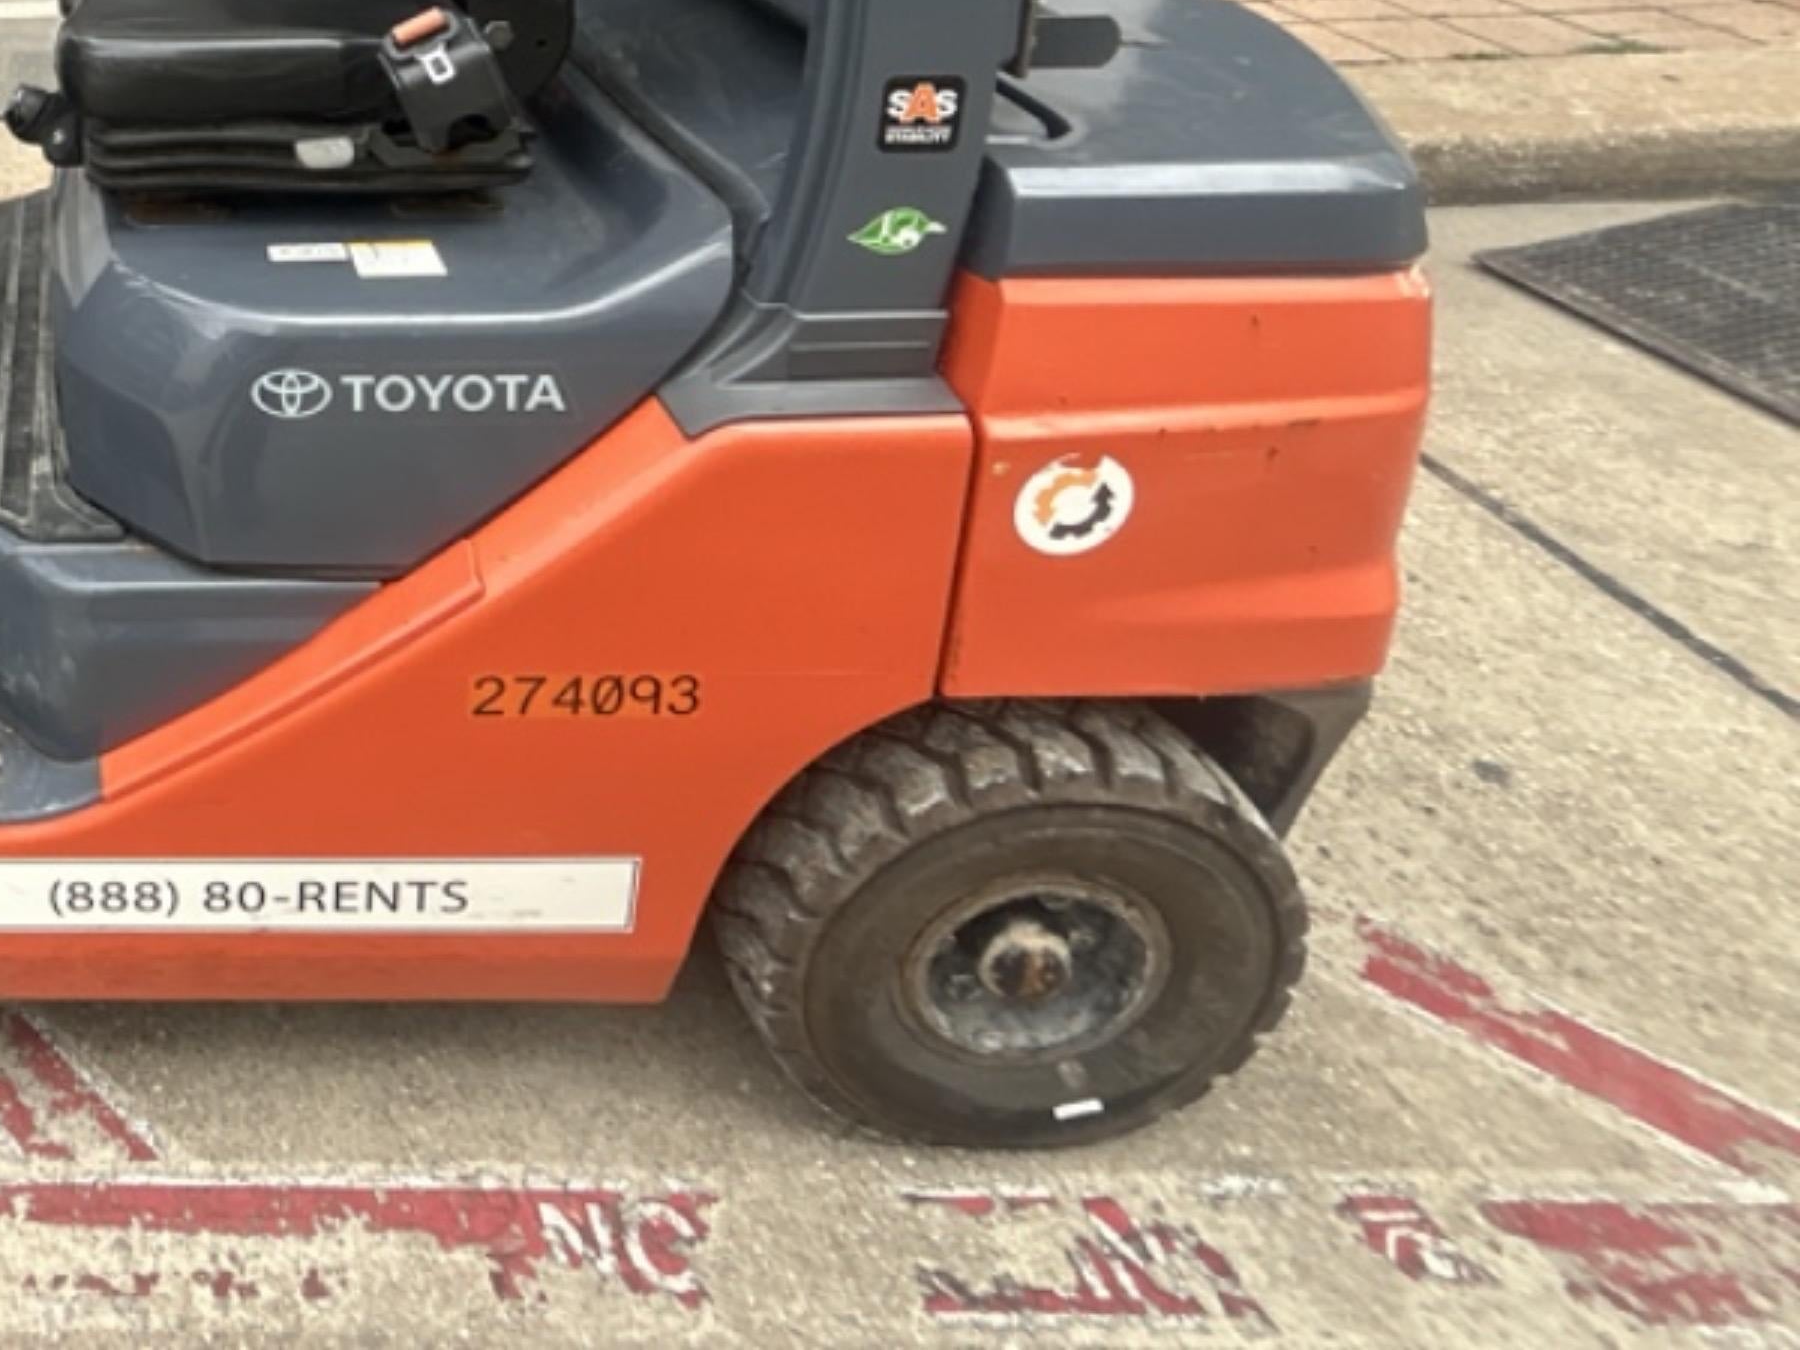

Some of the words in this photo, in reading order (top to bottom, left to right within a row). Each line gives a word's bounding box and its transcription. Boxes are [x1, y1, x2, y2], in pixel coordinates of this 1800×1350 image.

[887, 80, 958, 123] SAS
[339, 374, 566, 412] TOYOTA
[472, 674, 700, 715] 274093
[48, 880, 181, 915] (888)
[202, 880, 470, 914] 80-RENTS
